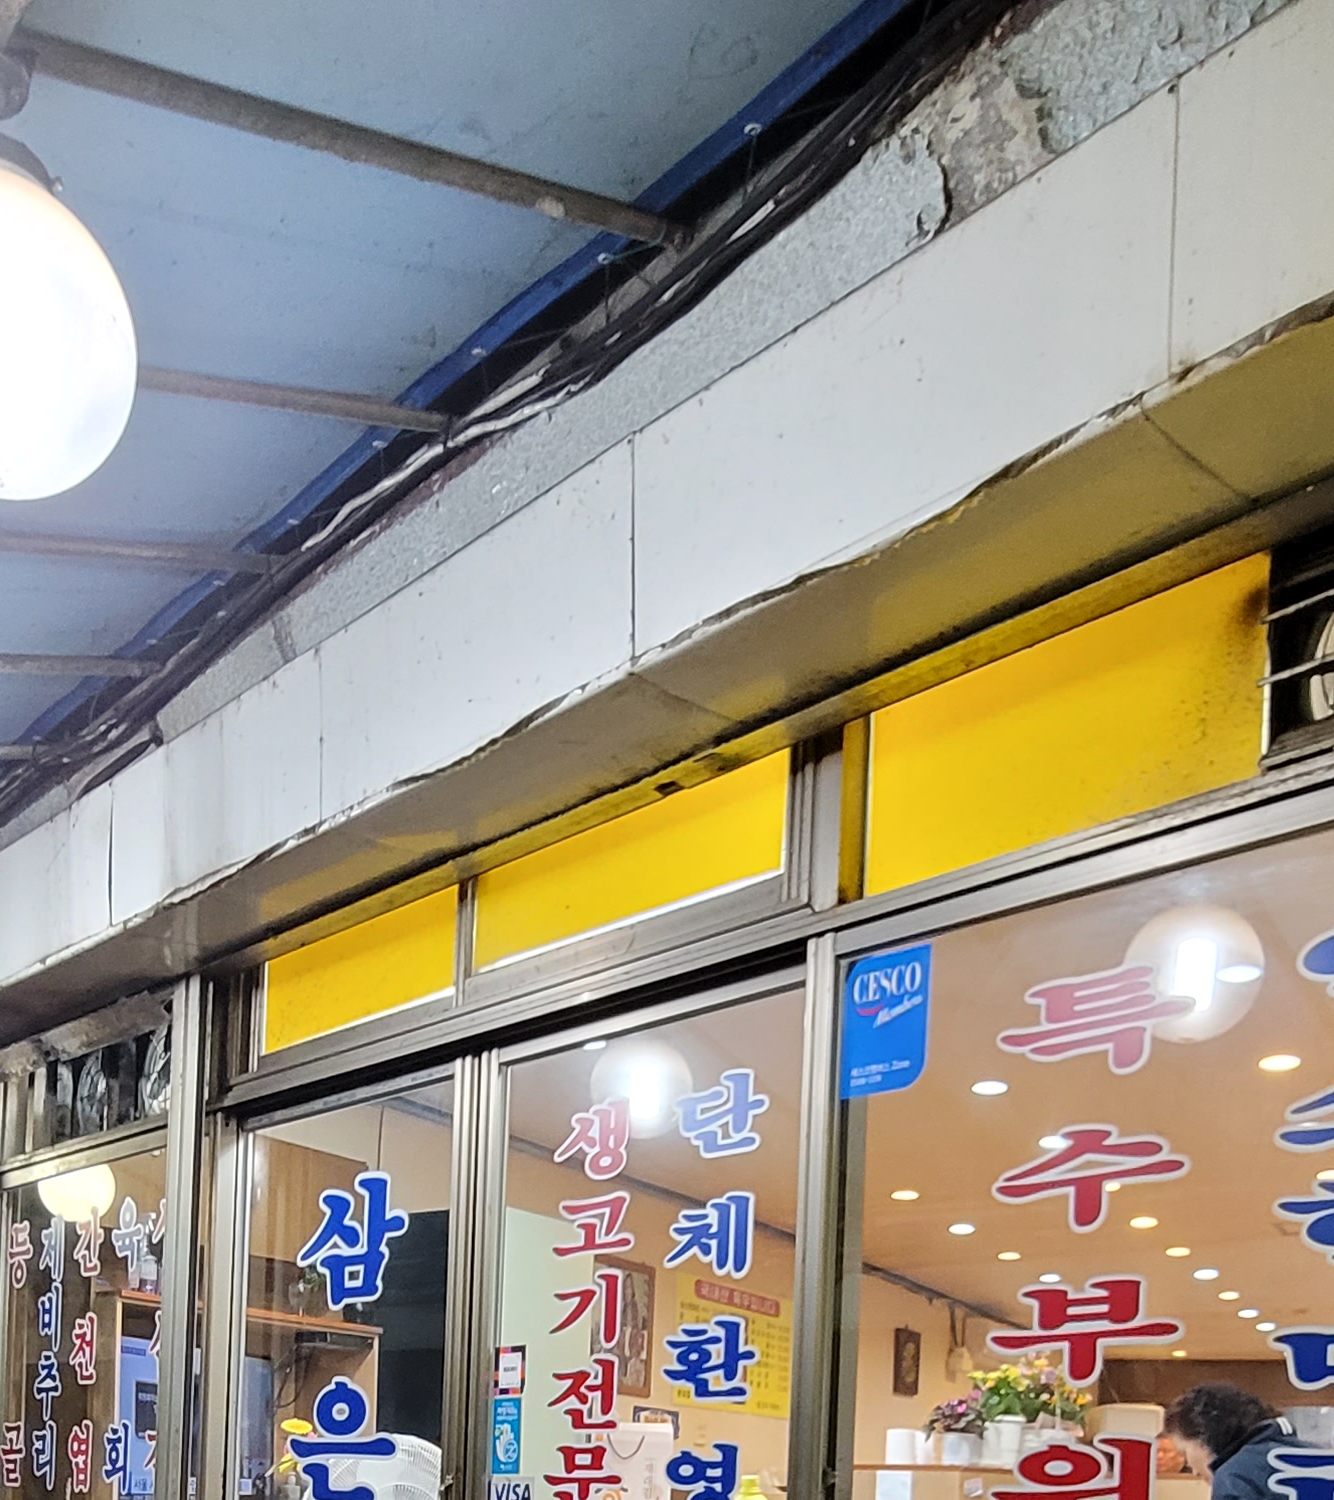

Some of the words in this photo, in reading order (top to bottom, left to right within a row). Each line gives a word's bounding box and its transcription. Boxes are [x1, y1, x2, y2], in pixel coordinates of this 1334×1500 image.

[853, 961, 922, 1004] CESCO
[0, 1221, 34, 1487] 등골
[32, 1214, 65, 1490] 제비추리
[68, 1207, 104, 1492] 간천엽
[103, 1198, 142, 1493] 육회
